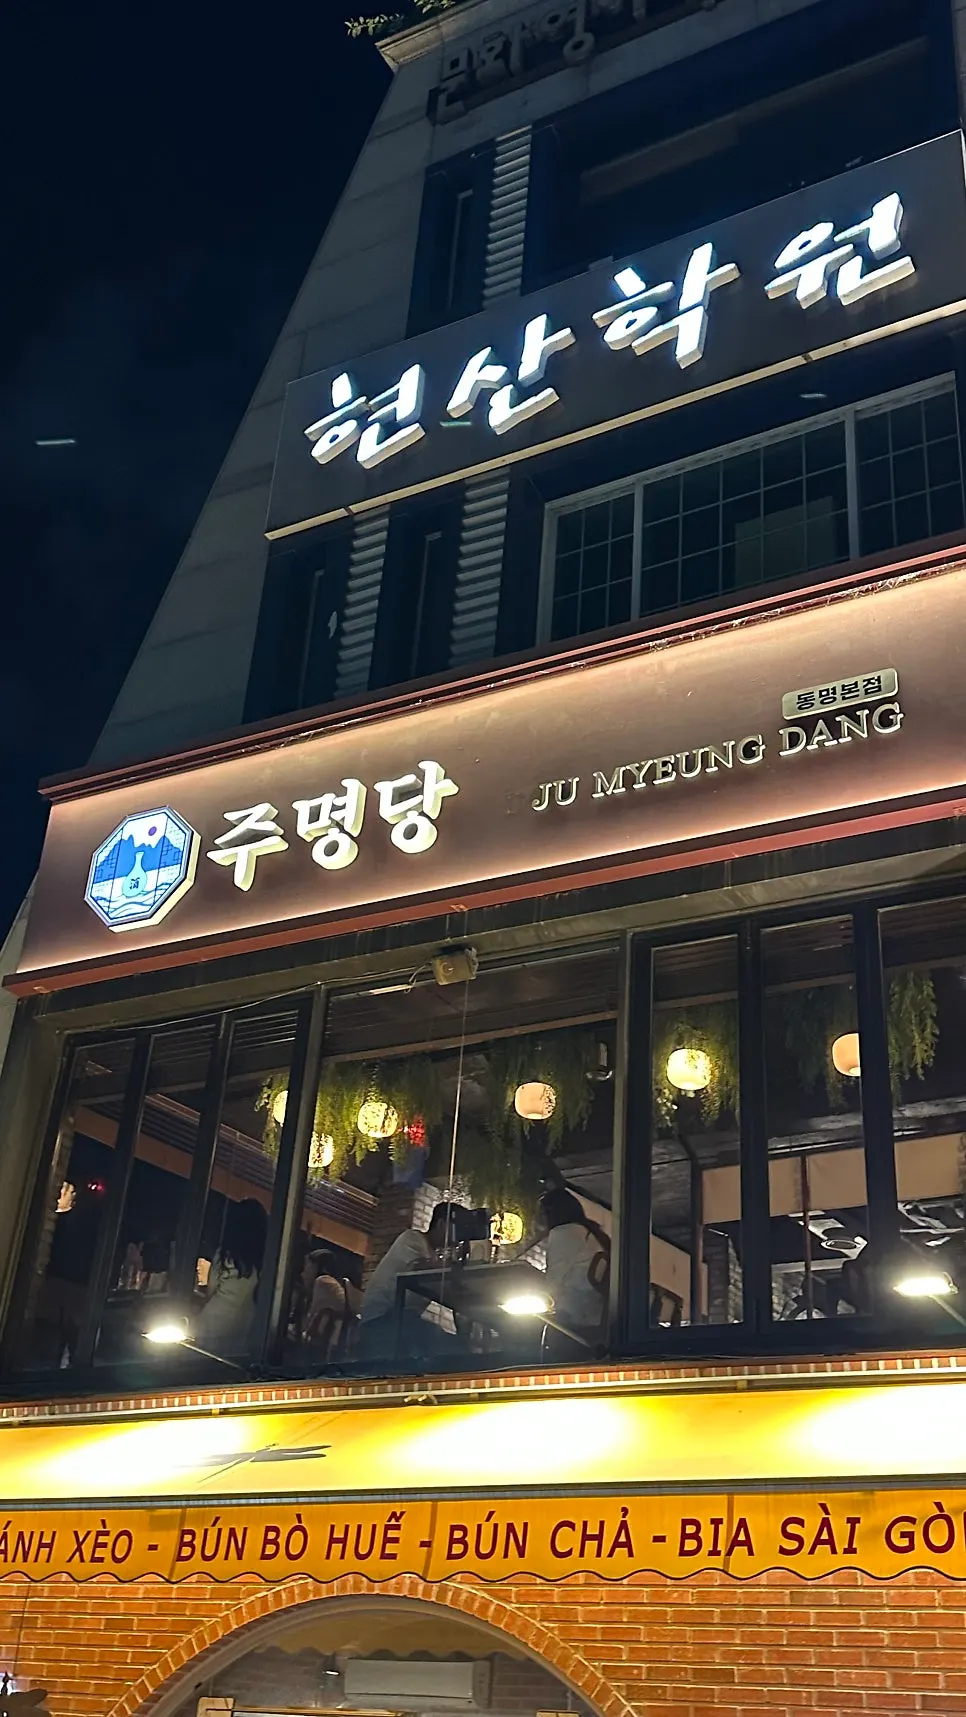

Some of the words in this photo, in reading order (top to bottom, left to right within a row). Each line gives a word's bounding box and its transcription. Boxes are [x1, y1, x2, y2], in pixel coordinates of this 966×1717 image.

[304, 192, 916, 469] 현산학원
[796, 675, 882, 711] 동명본점
[531, 776, 580, 811] JU
[592, 734, 766, 798] MYEUNG
[778, 701, 905, 757] DANG
[206, 760, 459, 892] 주명당
[66, 1518, 133, 1564] XÈO
[175, 1515, 249, 1563] BÚN
[259, 1513, 309, 1561] BÒ
[445, 1510, 529, 1560] BÚN
[549, 1506, 635, 1559] CHẢ
[678, 1517, 755, 1557] BIA
[778, 1502, 861, 1557] SÀI
[884, 1501, 966, 1554] GÒ
